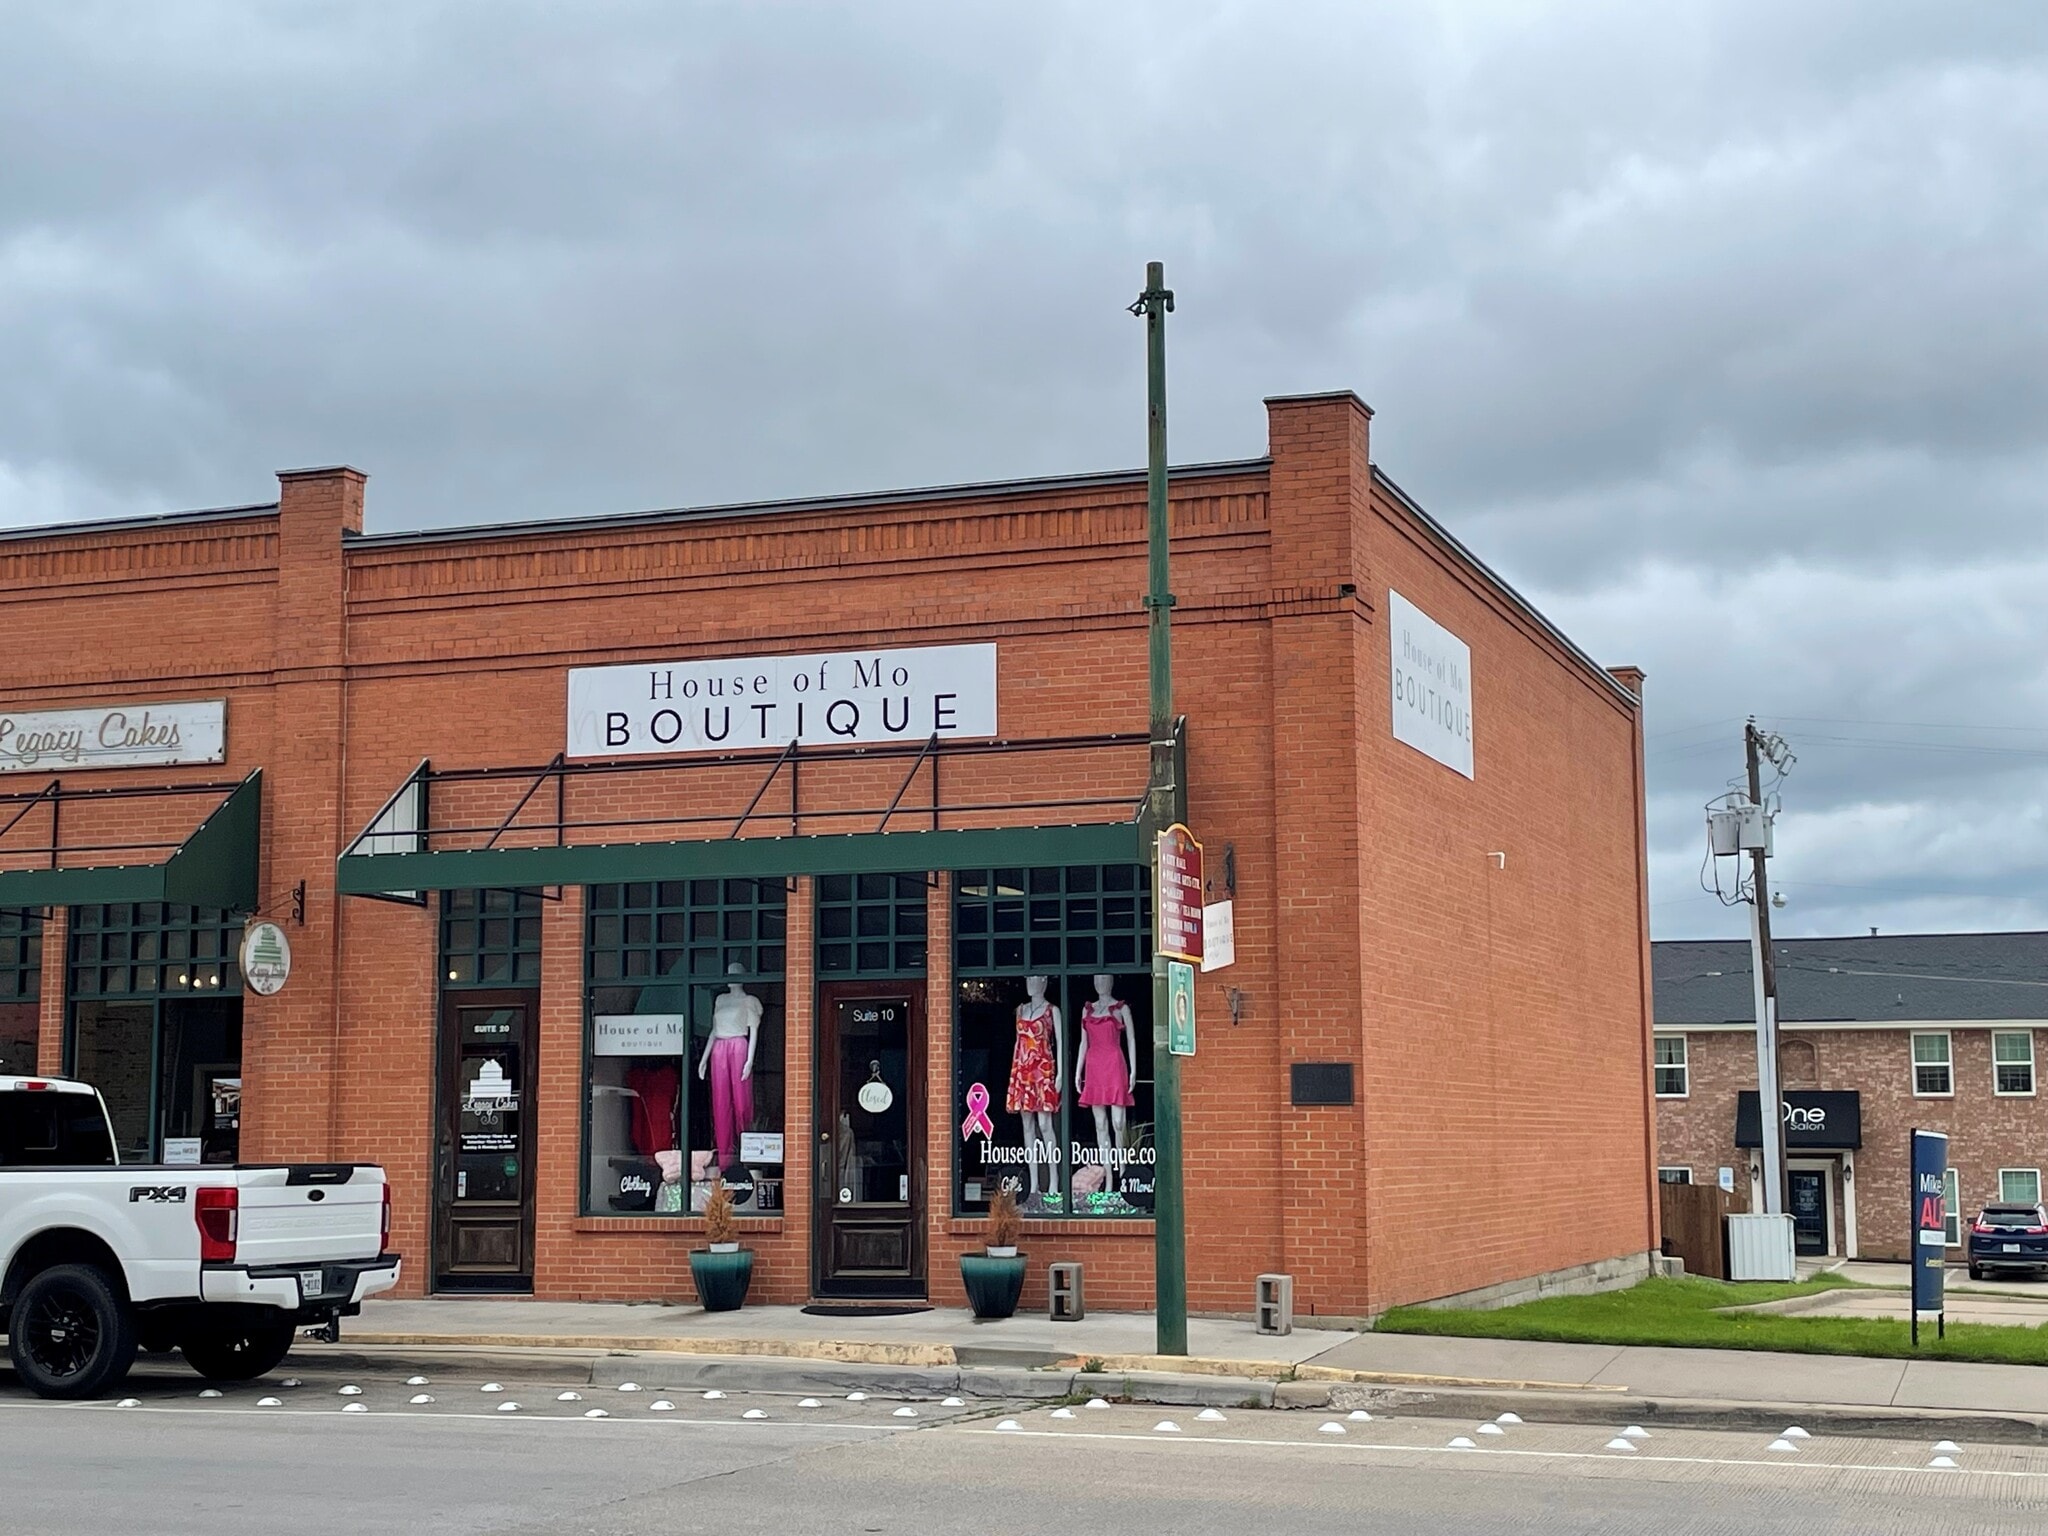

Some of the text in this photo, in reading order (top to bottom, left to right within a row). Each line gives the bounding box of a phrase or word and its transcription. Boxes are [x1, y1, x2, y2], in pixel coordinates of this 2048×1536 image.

[1403, 629, 1462, 694] House of Mo
[649, 658, 909, 700] House of Mo
[1396, 668, 1470, 743] BOUTIQUE
[99, 712, 180, 748] Cakes
[606, 693, 957, 746] BOUTIQUE
[853, 1009, 894, 1022] Suite 10
[474, 1024, 497, 1033] SUITE
[599, 1024, 639, 1035] House
[647, 1024, 659, 1034] of
[1790, 1121, 1825, 1131] Salon
[980, 1139, 1062, 1164] HouseofMo
[129, 1186, 187, 1202] FX4
[620, 1175, 652, 1198] Clothing
[1120, 1178, 1127, 1193] &
